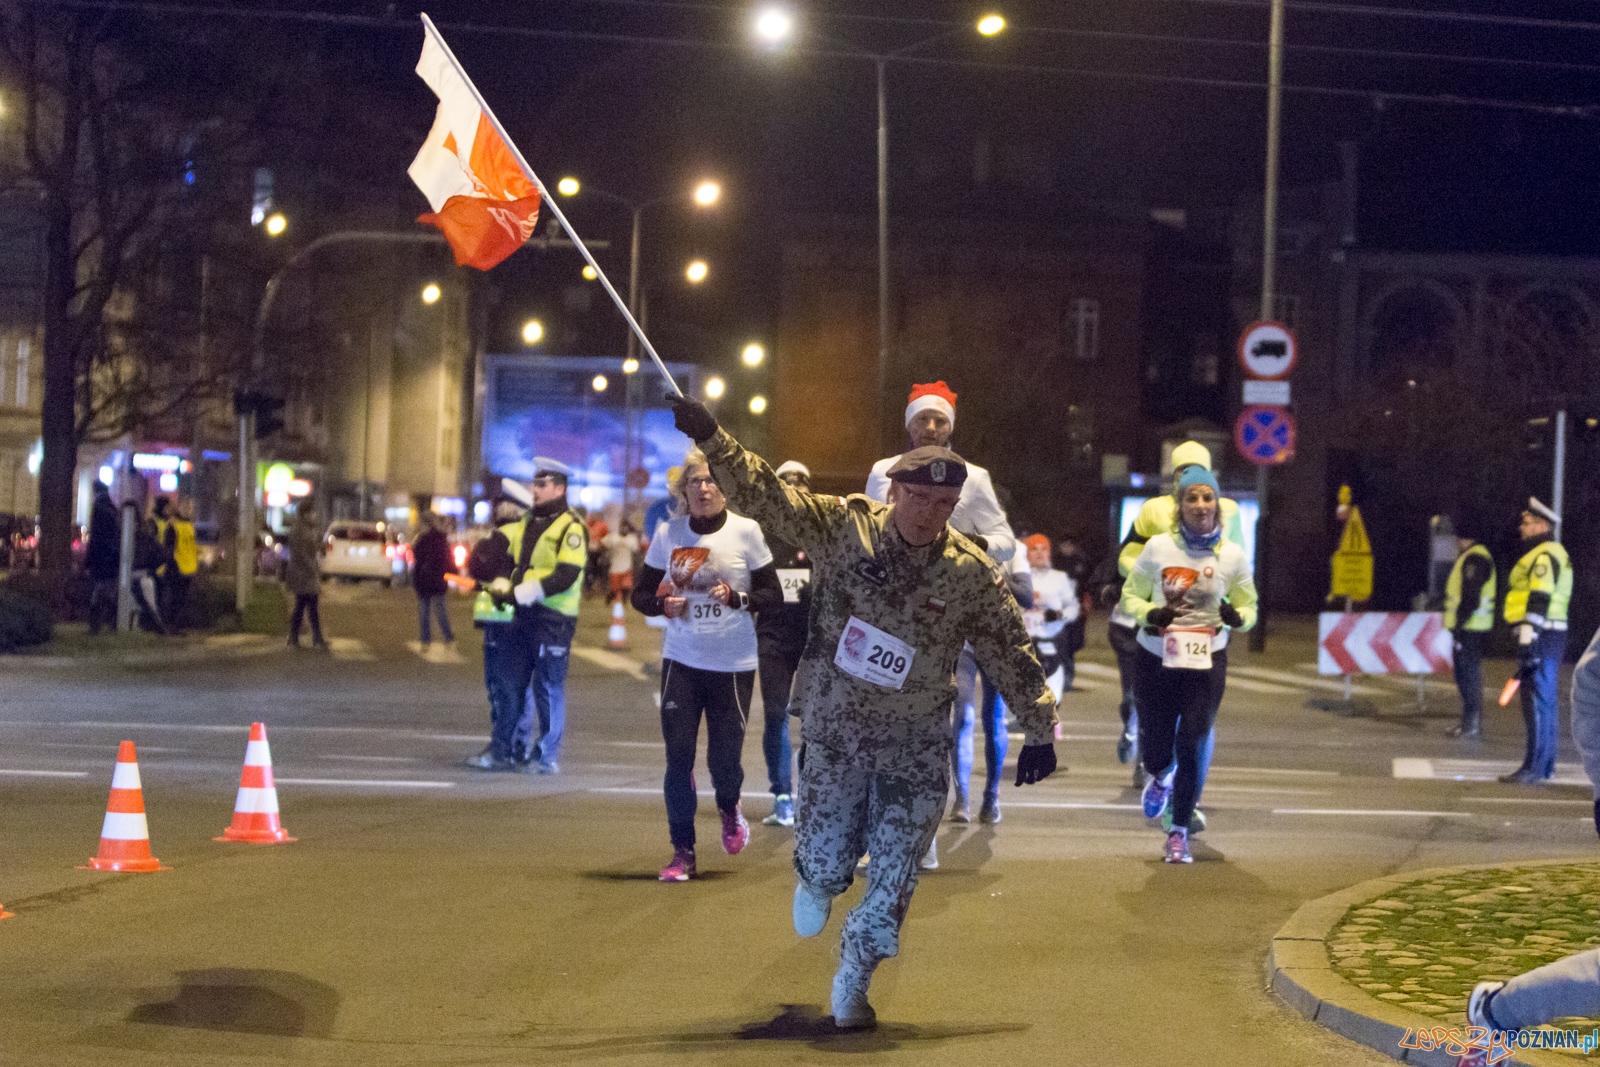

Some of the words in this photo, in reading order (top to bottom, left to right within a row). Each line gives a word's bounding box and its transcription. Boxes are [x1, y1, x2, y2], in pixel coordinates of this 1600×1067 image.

[693, 603, 722, 619] 376
[1184, 642, 1208, 655] 124
[867, 644, 906, 674] 209
